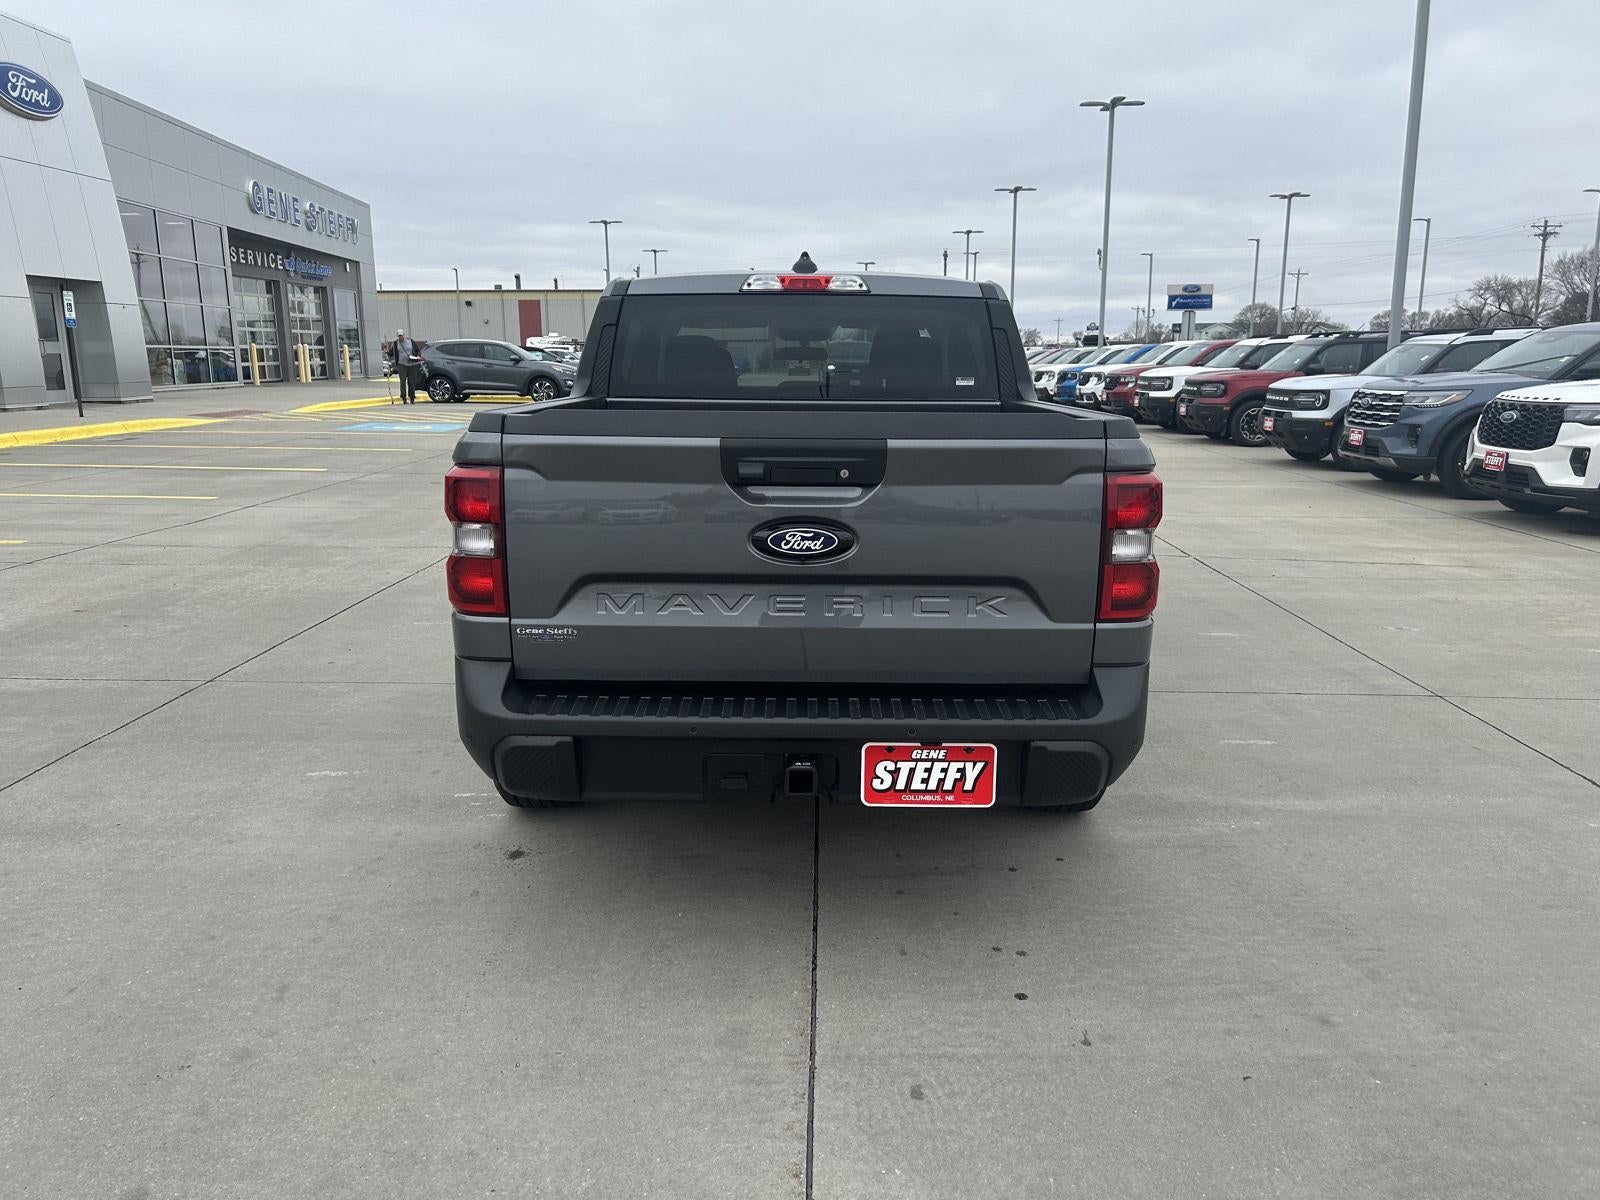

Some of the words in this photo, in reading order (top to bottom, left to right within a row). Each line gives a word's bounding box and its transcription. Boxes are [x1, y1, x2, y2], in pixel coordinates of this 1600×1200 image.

[8, 70, 51, 108] Ford
[248, 180, 301, 226] GENE
[305, 201, 359, 244] STEFFY
[229, 246, 284, 270] SERVICE
[780, 531, 825, 550] Ford
[596, 592, 1009, 618] MAVERICK
[546, 627, 577, 635] Steffy
[911, 749, 948, 759] GENE
[871, 760, 986, 791] STEFFY
[901, 794, 943, 802] COLUMBUS,
